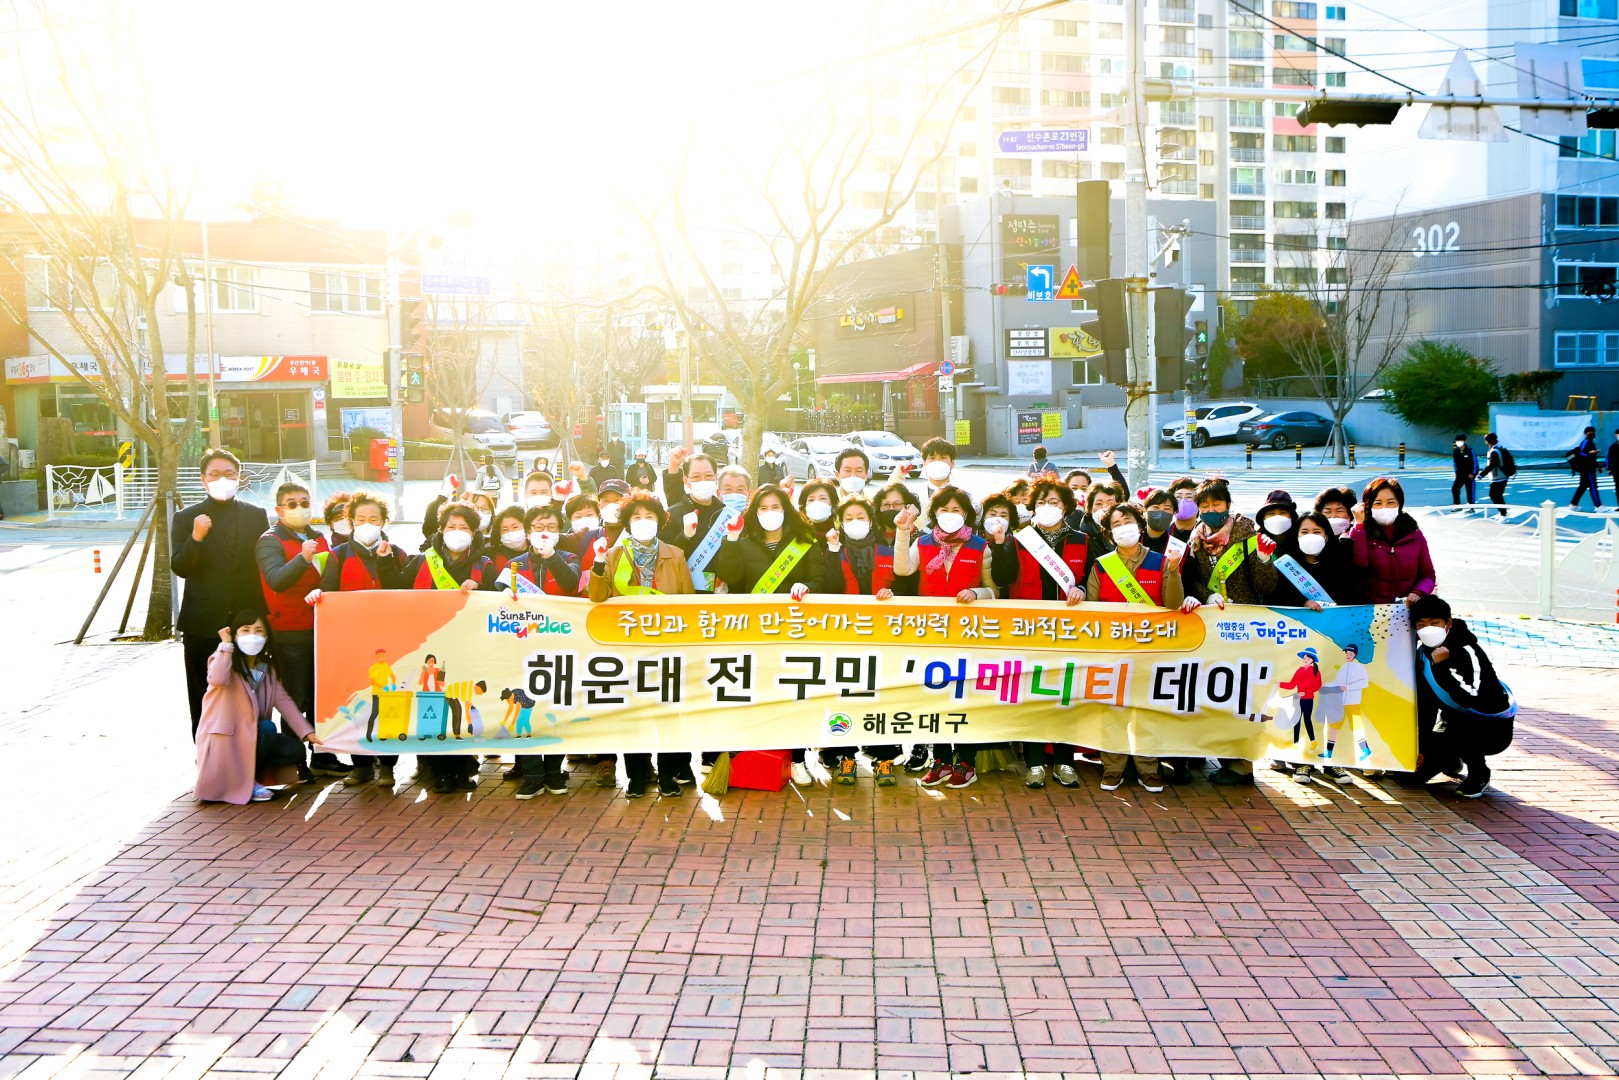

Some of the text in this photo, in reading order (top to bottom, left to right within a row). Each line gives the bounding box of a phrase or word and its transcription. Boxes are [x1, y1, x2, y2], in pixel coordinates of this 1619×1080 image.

[1412, 221, 1461, 258] 302
[1027, 290, 1052, 300] 비보호
[289, 366, 320, 376] 우체국
[337, 370, 352, 383] 불법
[500, 610, 544, 621] Sun&Fun
[617, 606, 1178, 643] 주민과 함께 만들어가는 경쟁력 있는 쾌적도시 해운대
[488, 613, 572, 638] Haeundae
[1216, 622, 1245, 631] 사람중심
[1250, 620, 1307, 644] 해운대
[1220, 631, 1250, 640] 미래도시
[527, 653, 682, 706] 해운대
[706, 653, 752, 702] 전
[778, 655, 877, 701] 구민
[862, 711, 969, 734] 해운대구
